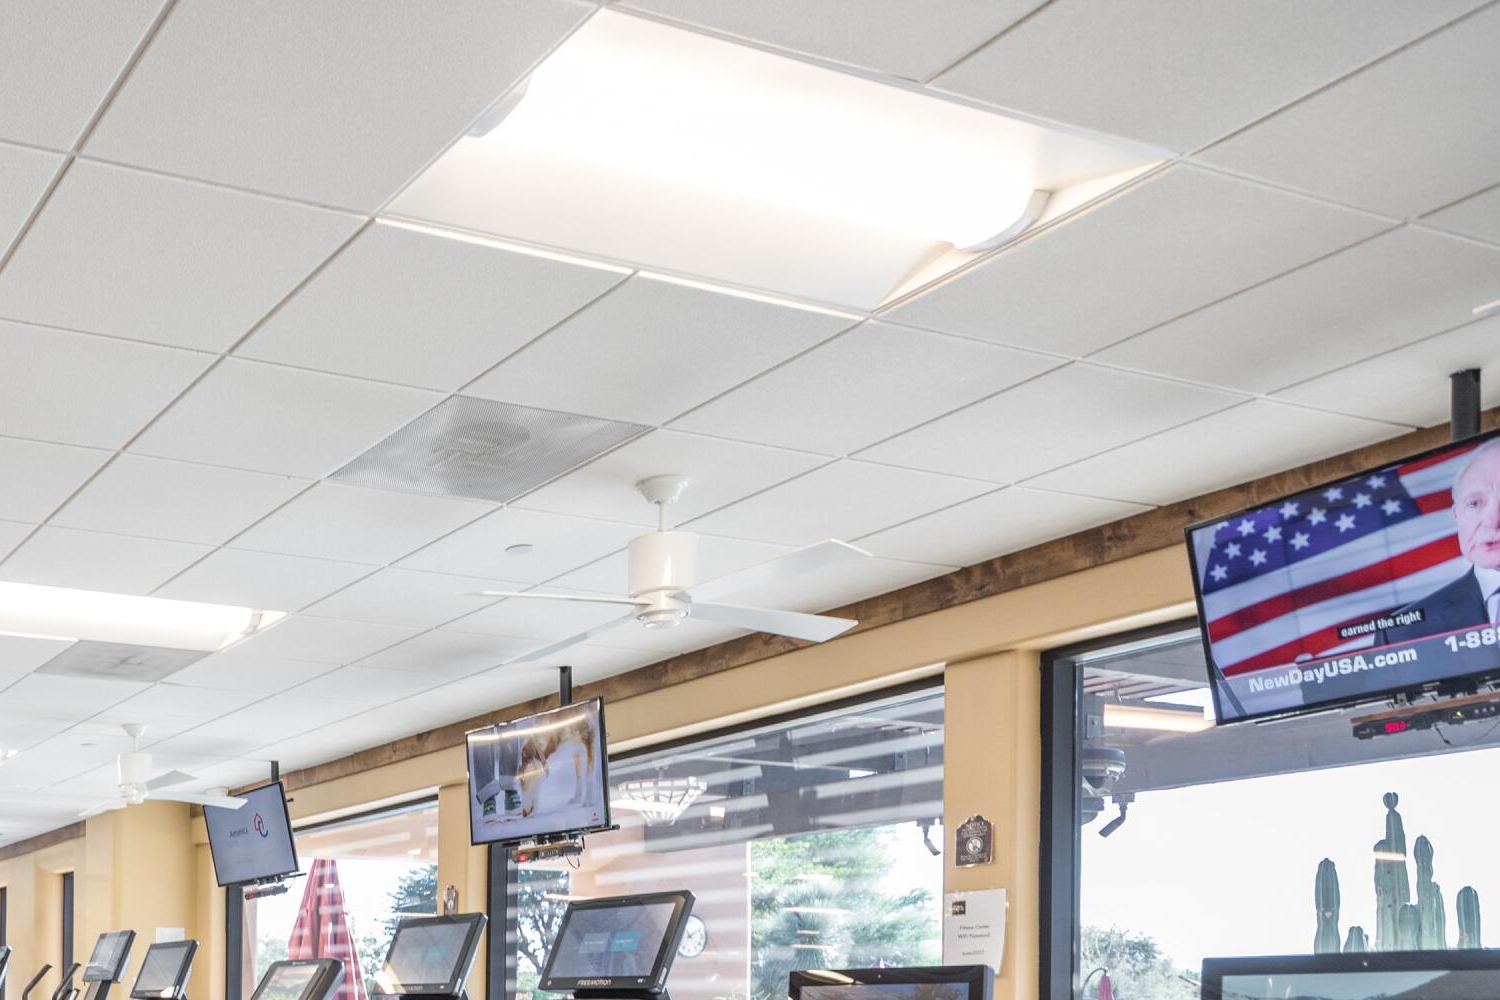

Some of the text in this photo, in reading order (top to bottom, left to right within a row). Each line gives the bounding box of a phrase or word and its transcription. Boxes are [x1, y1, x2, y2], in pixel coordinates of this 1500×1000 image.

[1341, 610, 1421, 637] earned the right
[1249, 648, 1418, 693] NewDayUSA.com
